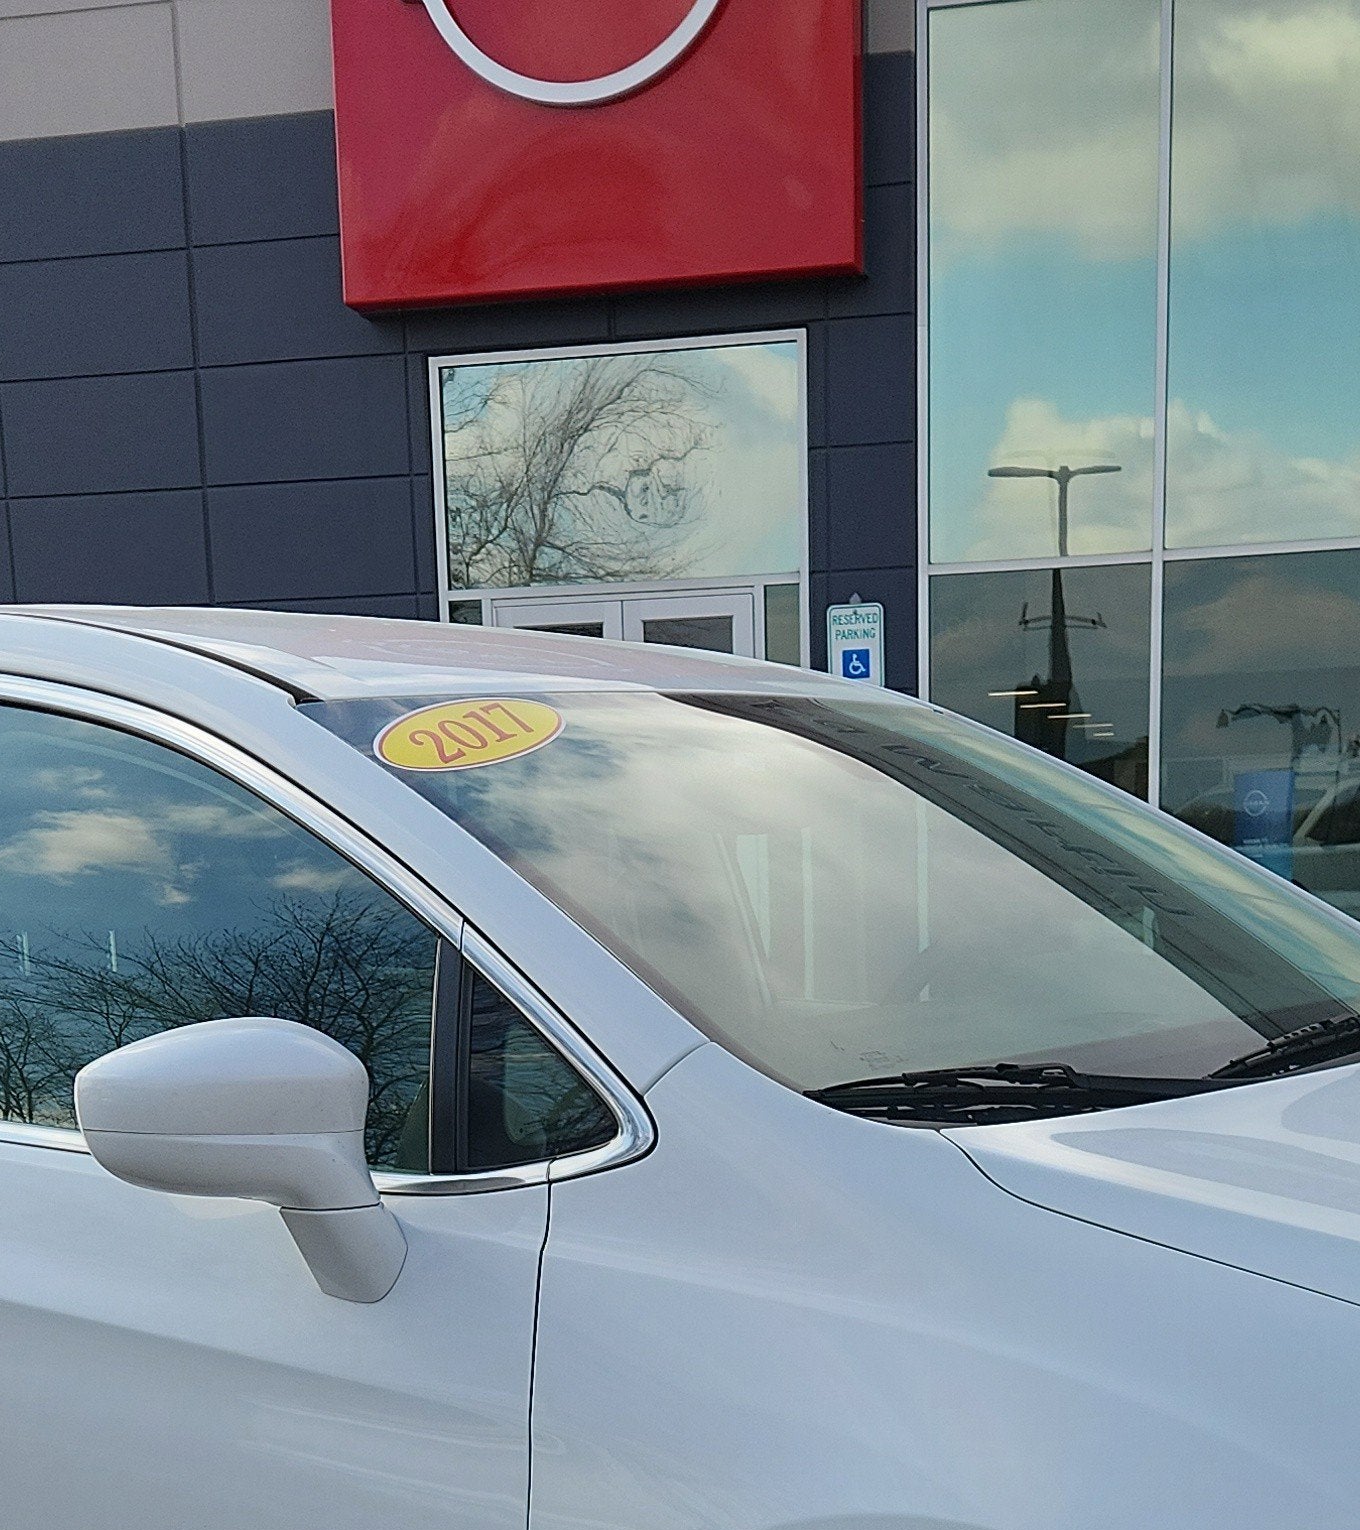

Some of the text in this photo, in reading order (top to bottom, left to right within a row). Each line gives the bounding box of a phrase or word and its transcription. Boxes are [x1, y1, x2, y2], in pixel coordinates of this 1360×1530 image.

[832, 613, 878, 625] RESERVED
[835, 627, 876, 640] PARKING
[409, 702, 535, 765] 2017
